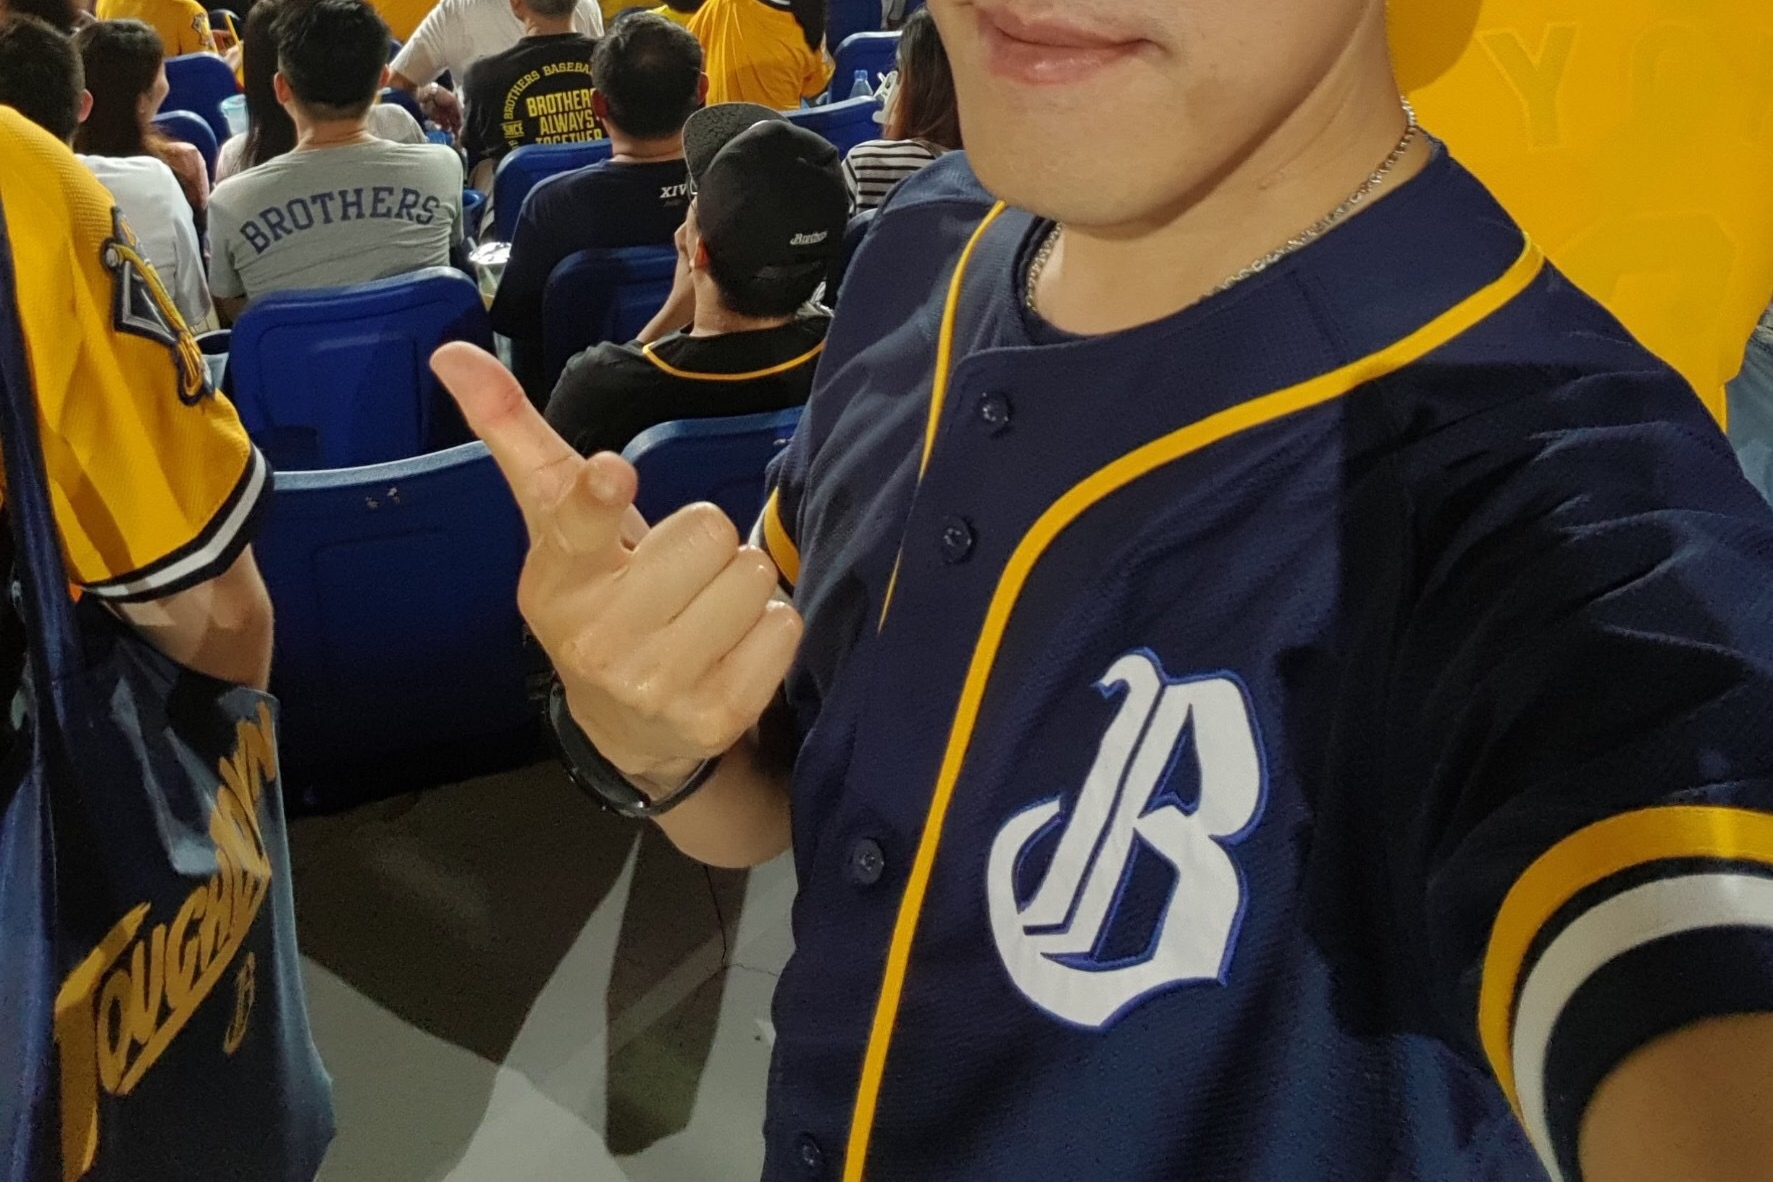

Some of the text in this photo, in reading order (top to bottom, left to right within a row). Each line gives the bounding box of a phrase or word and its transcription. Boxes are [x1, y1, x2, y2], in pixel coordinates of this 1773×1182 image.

[503, 62, 593, 120] BROTHERS BASEBA
[527, 87, 595, 118] BROTHER
[540, 109, 595, 136] ALWAYS
[240, 186, 440, 254] BROTHERS
[789, 230, 828, 245] Brothers
[986, 648, 1268, 1029] B
